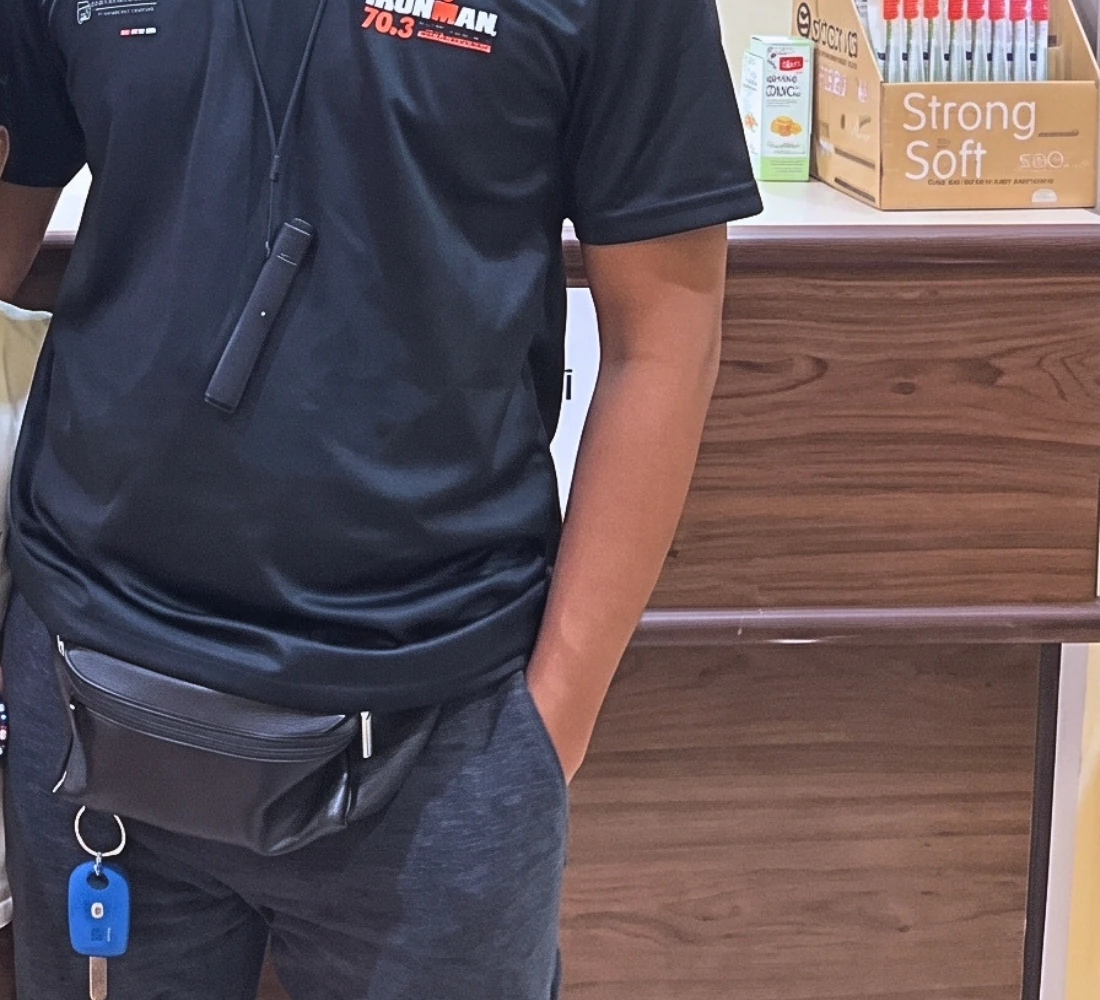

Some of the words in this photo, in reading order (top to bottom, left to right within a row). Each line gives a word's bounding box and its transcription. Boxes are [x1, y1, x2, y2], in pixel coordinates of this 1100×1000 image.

[361, 6, 415, 39] 70.3
[903, 92, 1036, 140] Strong
[905, 139, 987, 180] Soft
